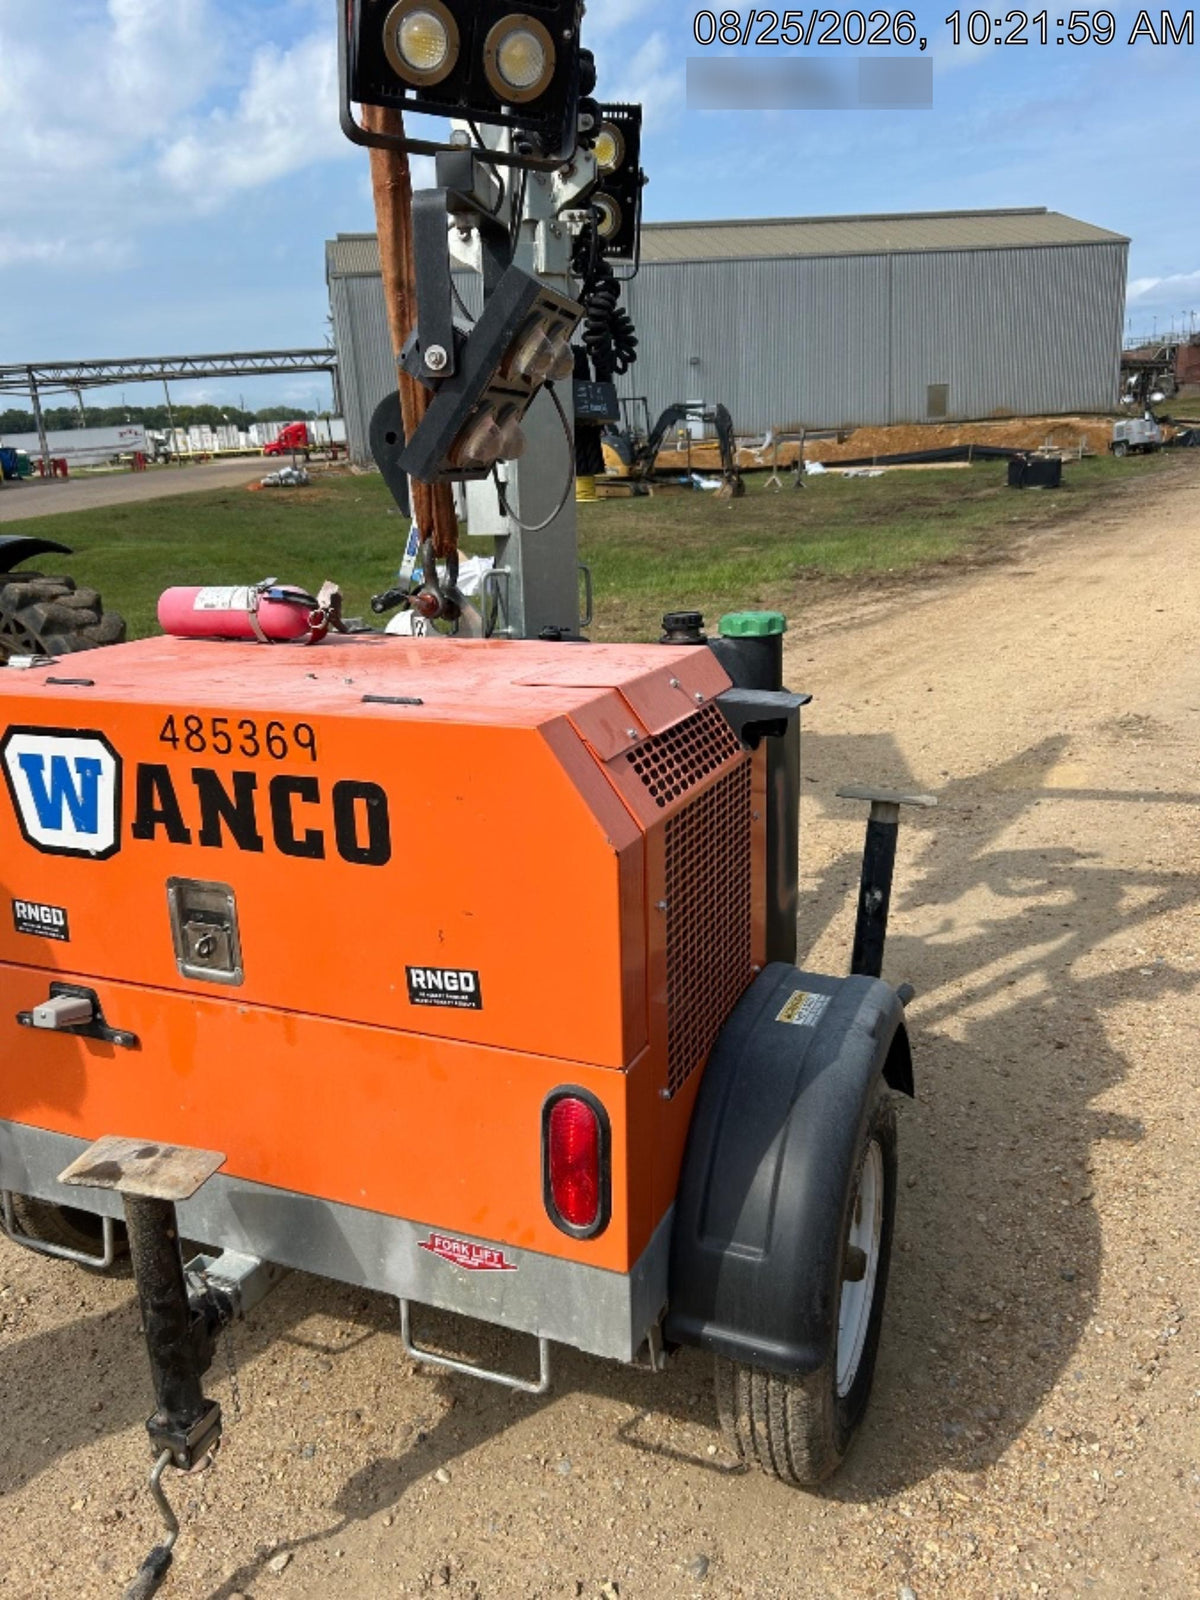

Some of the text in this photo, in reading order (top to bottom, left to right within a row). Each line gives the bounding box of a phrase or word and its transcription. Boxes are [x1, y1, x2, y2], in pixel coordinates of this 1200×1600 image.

[159, 714, 318, 762] 485369
[18, 752, 392, 867] WANCO
[15, 901, 65, 927] RNGD
[410, 968, 476, 993] RNGD
[434, 1237, 500, 1261] FORK LIFT
